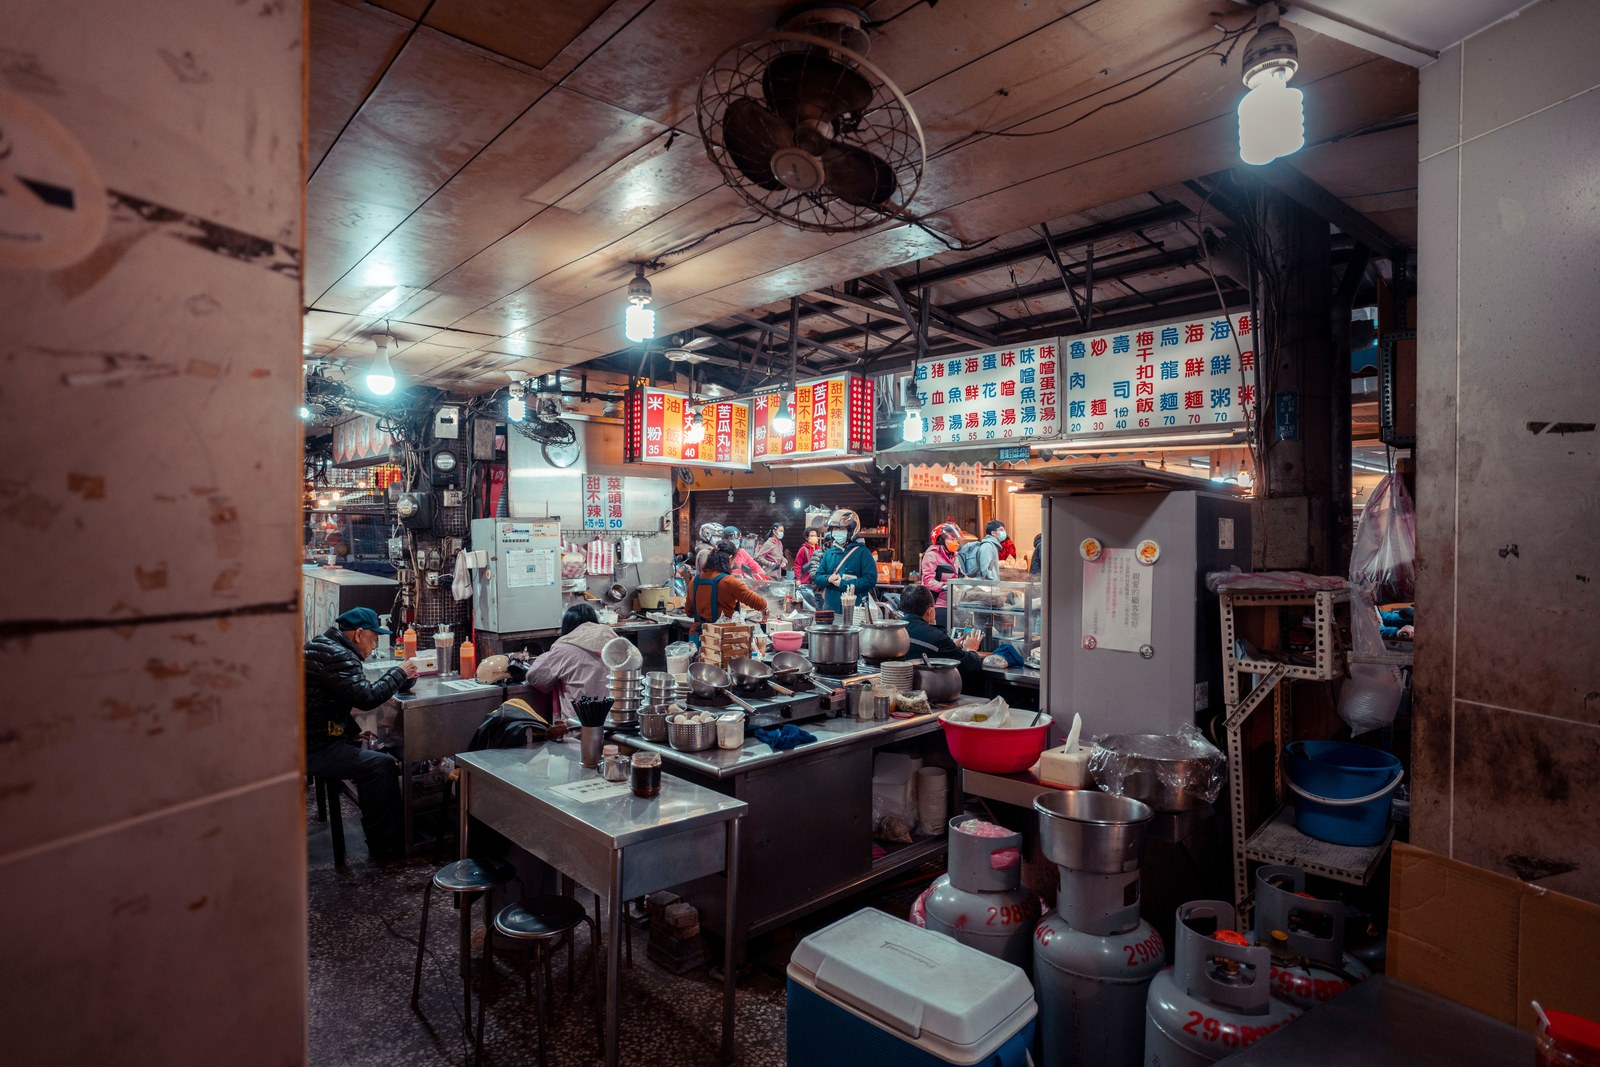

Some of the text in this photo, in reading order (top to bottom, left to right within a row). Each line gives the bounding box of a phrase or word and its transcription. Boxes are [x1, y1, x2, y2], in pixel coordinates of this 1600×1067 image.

[830, 382, 843, 420] 甜不辣
[931, 363, 945, 443] 猪血湯 30
[948, 360, 962, 442] 鮮魚湯 55
[965, 358, 979, 429] 海鮮湯
[982, 354, 997, 439] 蛋花湯 20
[1001, 352, 1016, 425] 味噌湯
[1020, 348, 1036, 435] 味噌魚湯 70
[1039, 346, 1056, 434] 味噌蛋花湯 30
[1069, 341, 1086, 432] 魯肉飯 20
[1090, 338, 1107, 431] 炒麵 30
[1112, 335, 1131, 429] 壽司 1份 40
[1136, 331, 1154, 428] 梅干扣肉飯 65
[1160, 327, 1179, 425] 烏龍麵 70
[1184, 324, 1204, 424] 海鮮麵 70
[1210, 321, 1231, 422] 海鮮粥 70
[647, 396, 663, 454] 米粉 35
[665, 398, 681, 457] 油飯 35
[717, 405, 731, 447] 苦瓜丸
[735, 407, 746, 440] 甜不辣
[755, 396, 767, 454] 米粉 35
[798, 388, 811, 435] 甜不辣
[813, 384, 827, 435] 苦瓜丸
[1242, 410, 1255, 420] 70
[684, 448, 695, 457] 40
[770, 443, 778, 453] 35
[784, 440, 793, 450] 40
[587, 476, 601, 517] 甜不辣
[607, 477, 623, 528] 菜頭湯 50
